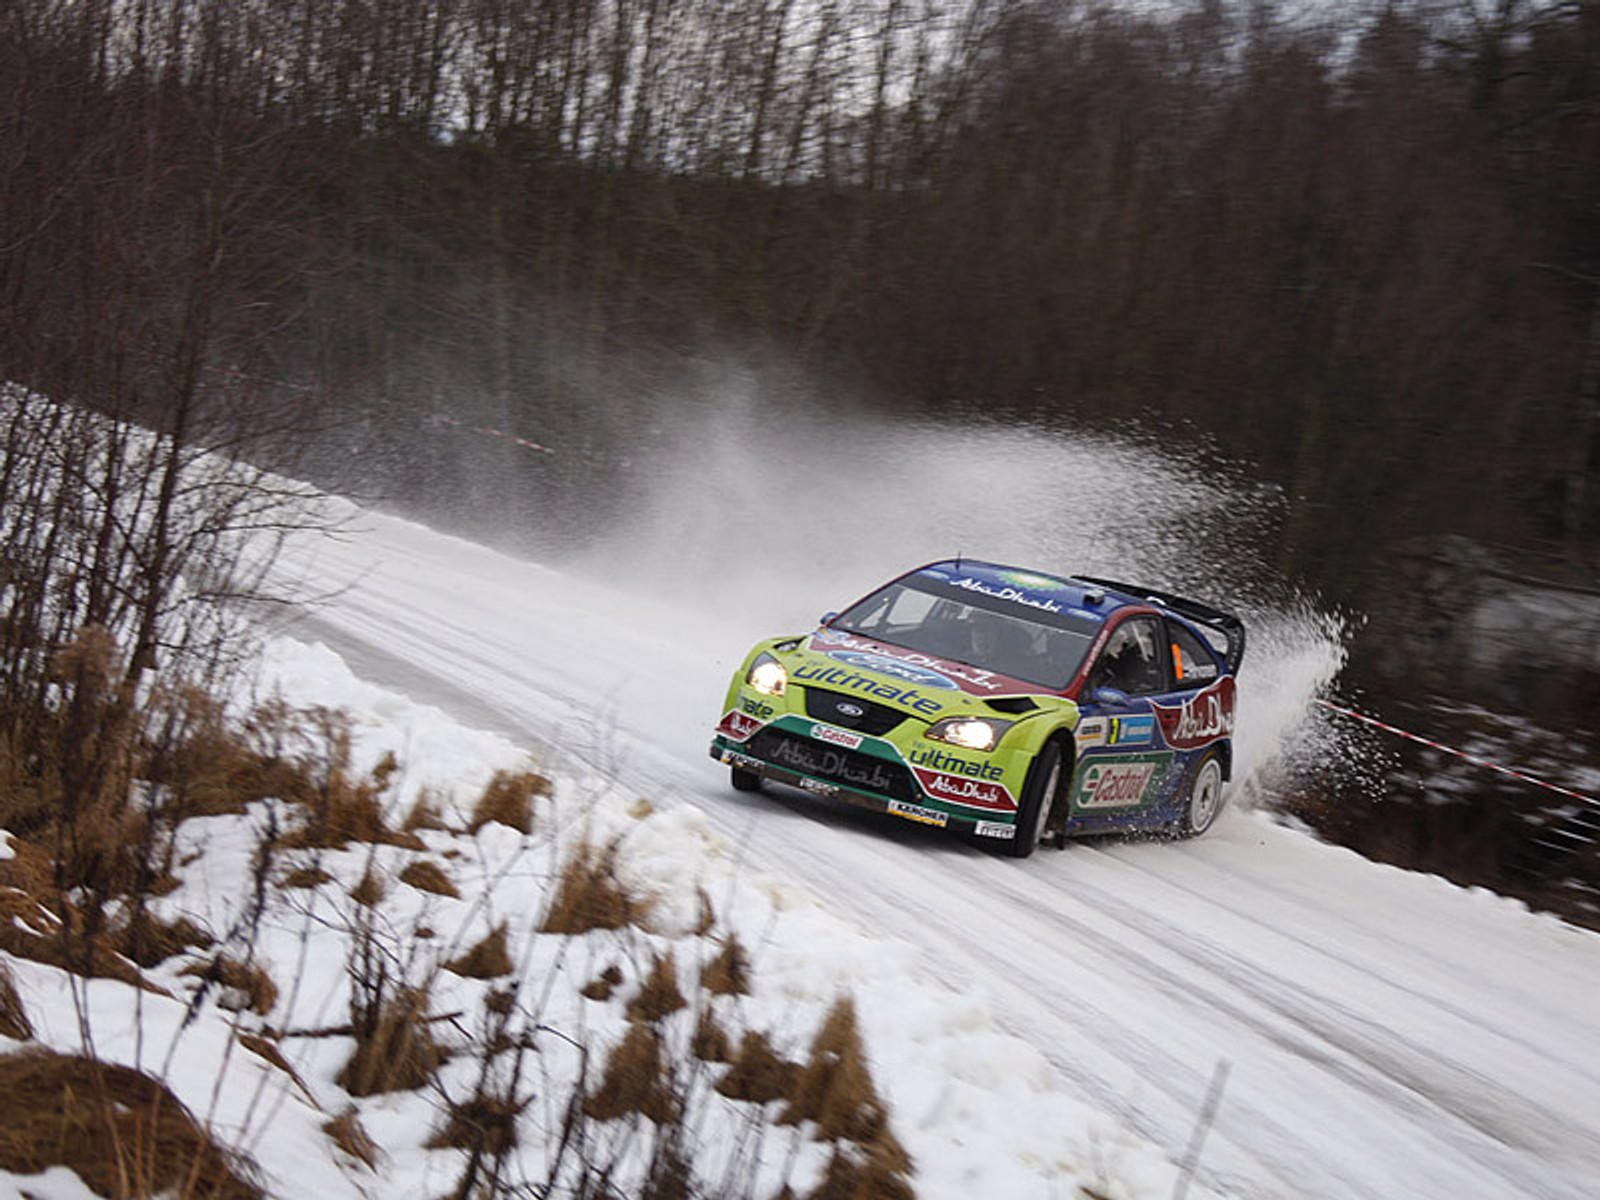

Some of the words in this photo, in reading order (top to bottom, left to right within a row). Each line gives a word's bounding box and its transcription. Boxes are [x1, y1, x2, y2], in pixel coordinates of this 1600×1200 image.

[950, 577, 996, 597] Abu
[995, 587, 1062, 613] Dhabi
[793, 665, 942, 716] ultimate
[822, 729, 860, 748] Castrol
[770, 738, 819, 771] Abu
[819, 751, 893, 790] Dhabi
[909, 749, 1004, 781] ultimate
[928, 775, 962, 797] Abu
[1093, 768, 1149, 802] Castrol
